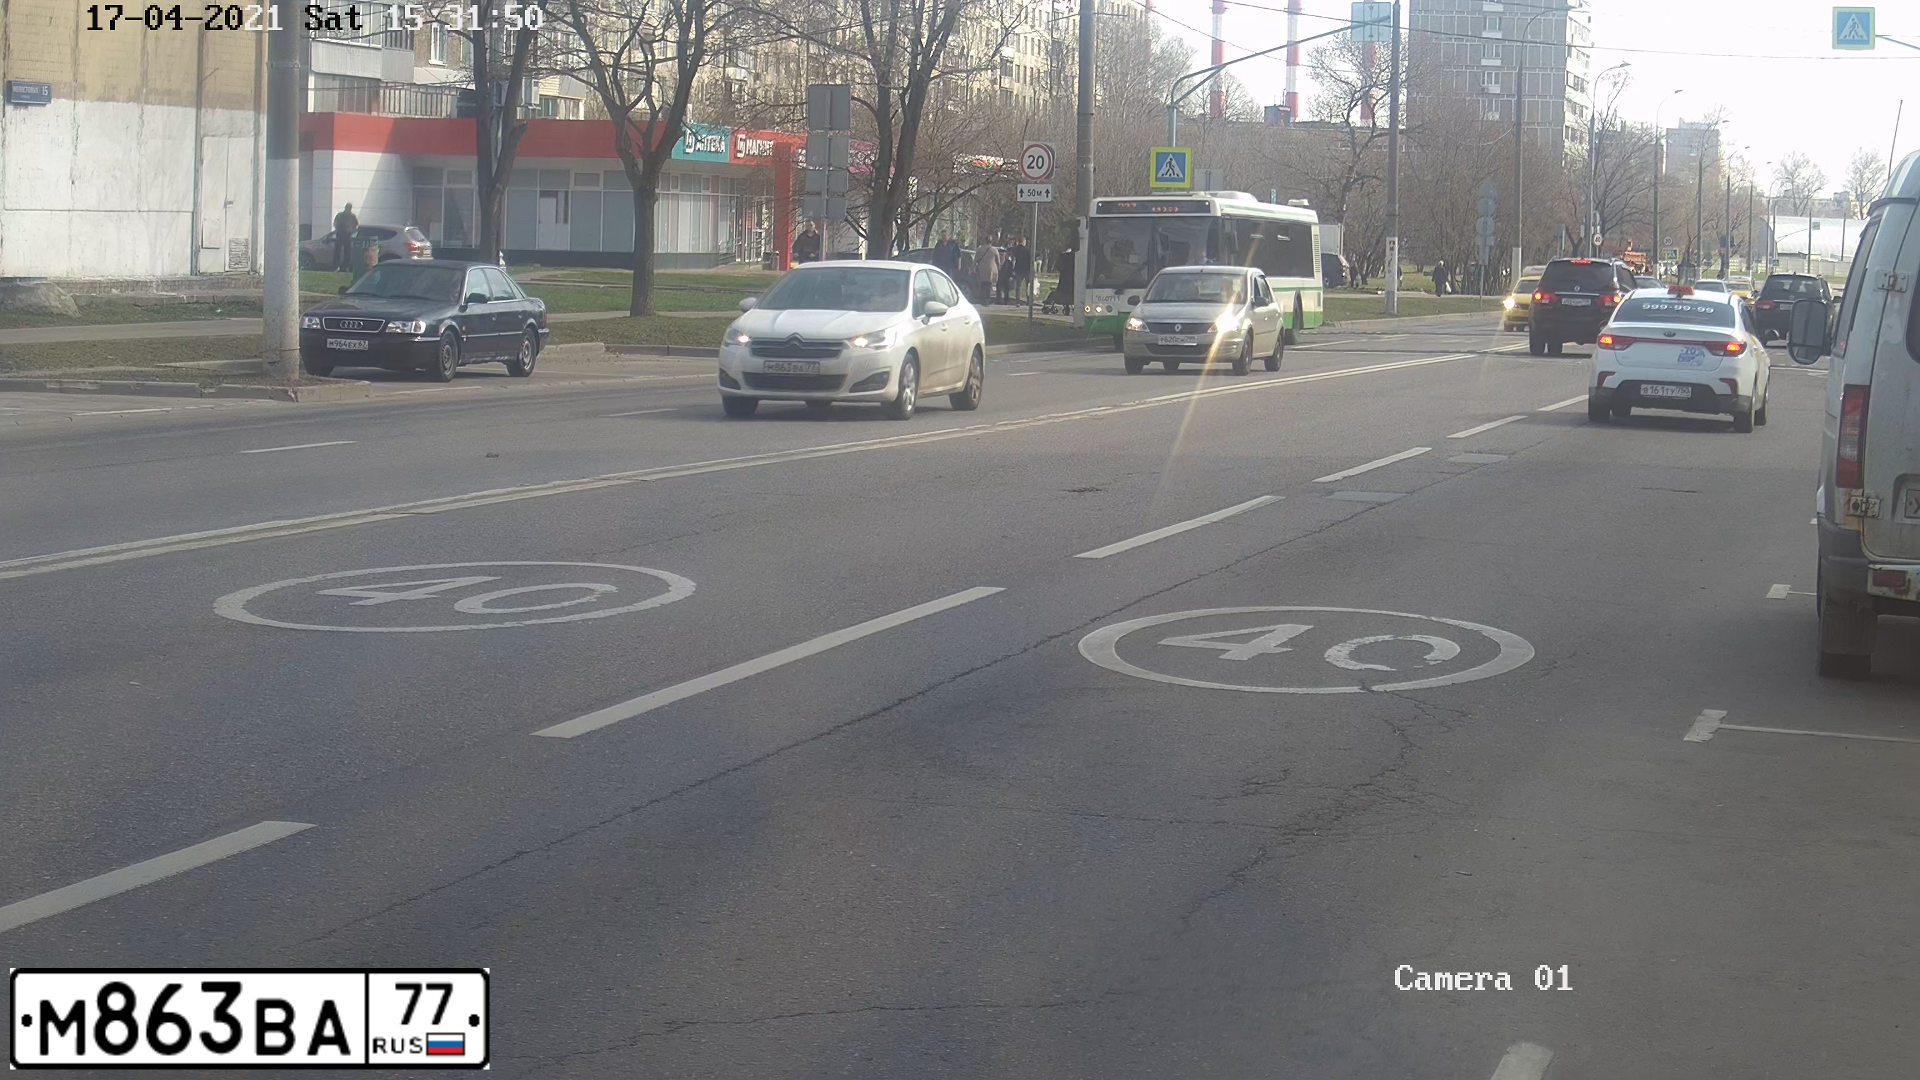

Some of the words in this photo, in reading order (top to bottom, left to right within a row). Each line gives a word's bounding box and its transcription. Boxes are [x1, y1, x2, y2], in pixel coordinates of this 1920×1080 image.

[42, 85, 49, 96] 15
[695, 134, 726, 153] АПТЕКА
[1026, 154, 1045, 170] 20
[1642, 302, 1715, 314] 999-99-99
[317, 576, 618, 614] 40
